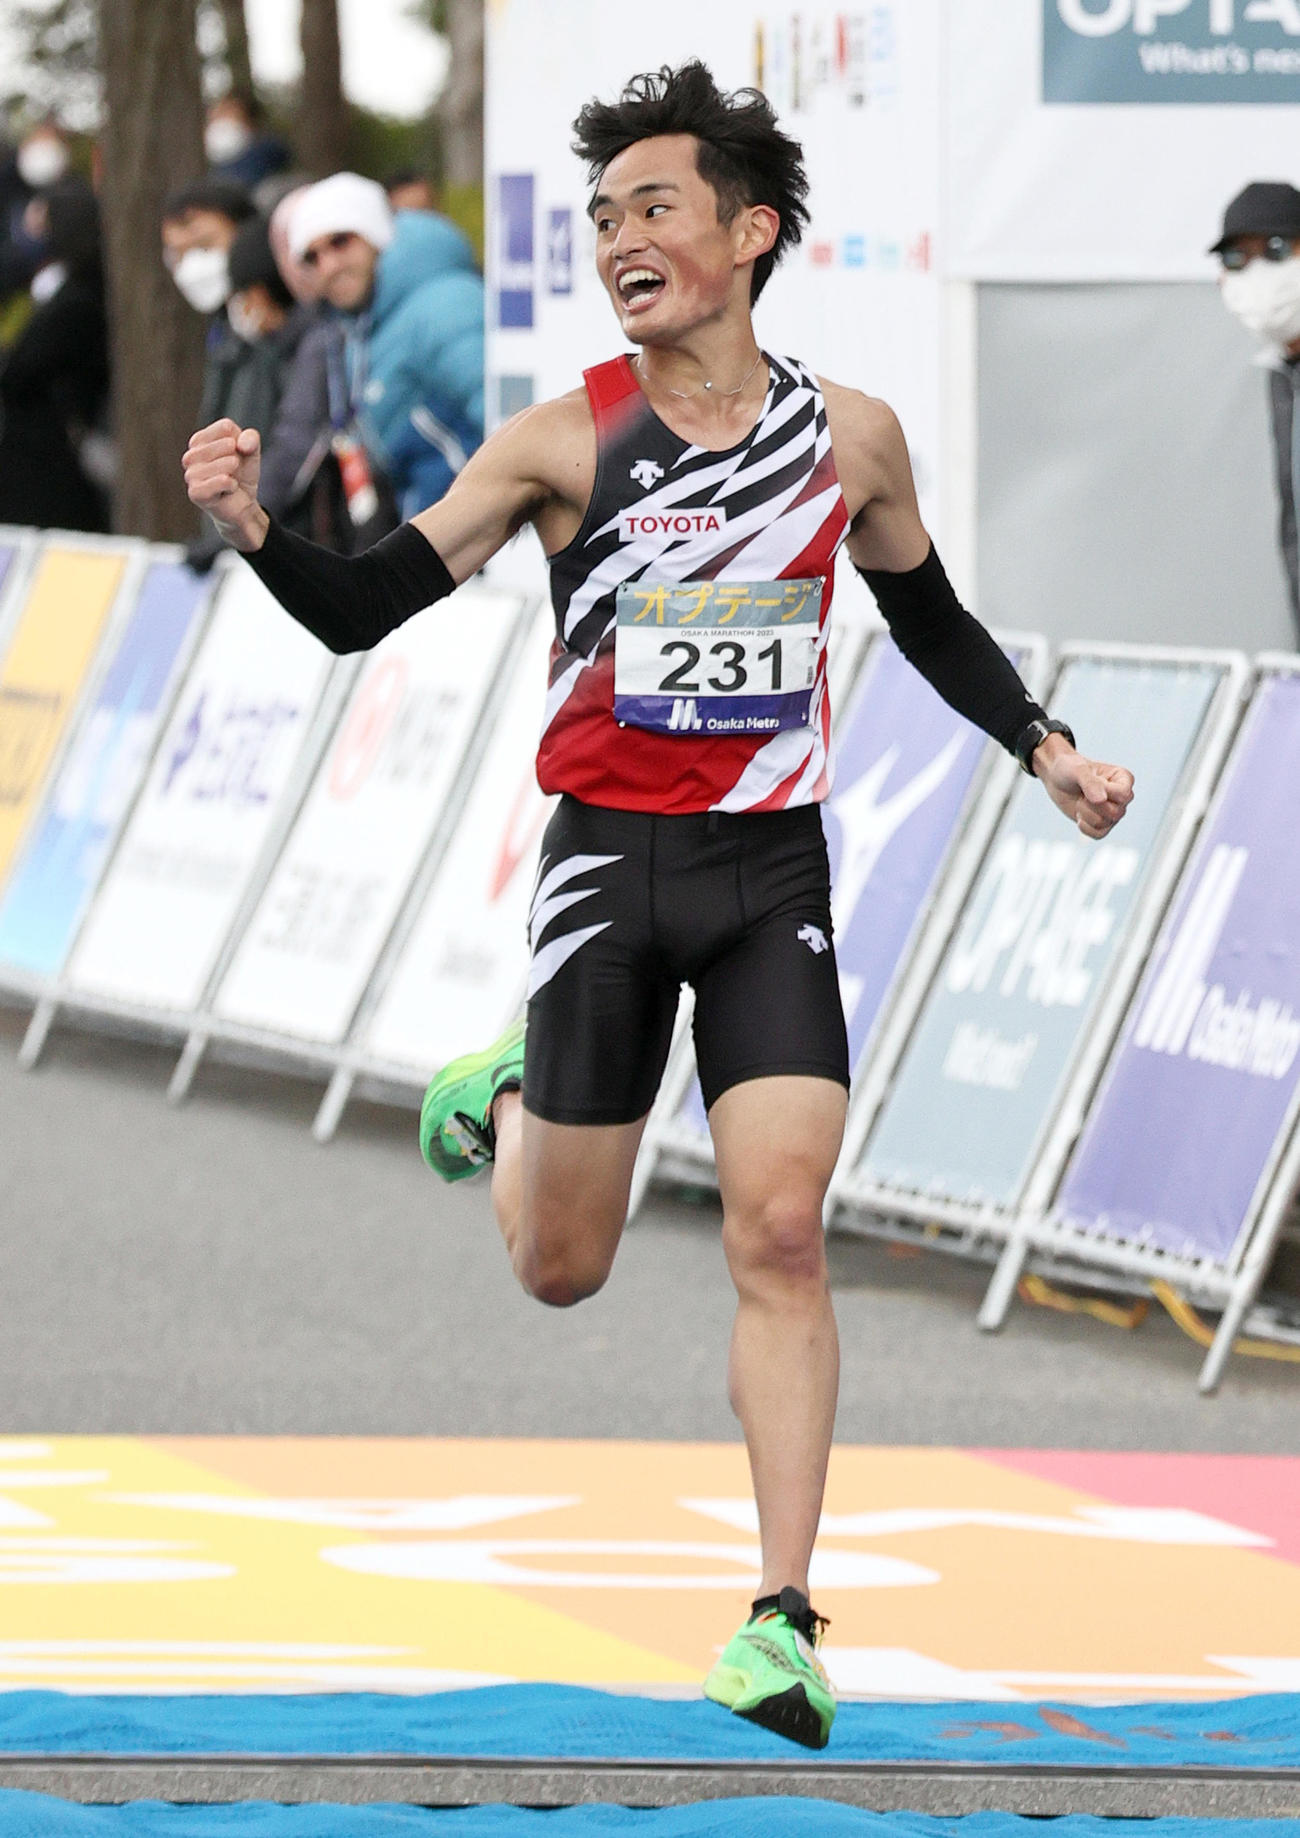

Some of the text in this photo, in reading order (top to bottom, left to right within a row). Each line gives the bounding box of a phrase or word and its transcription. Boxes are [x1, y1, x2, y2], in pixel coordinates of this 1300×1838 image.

[625, 514, 720, 534] TOYOTA
[633, 581, 812, 625] オプテージ
[681, 629, 708, 638] OSAKA
[710, 629, 755, 637] MARATHON
[658, 638, 782, 692] 231
[706, 717, 745, 730] Osaka
